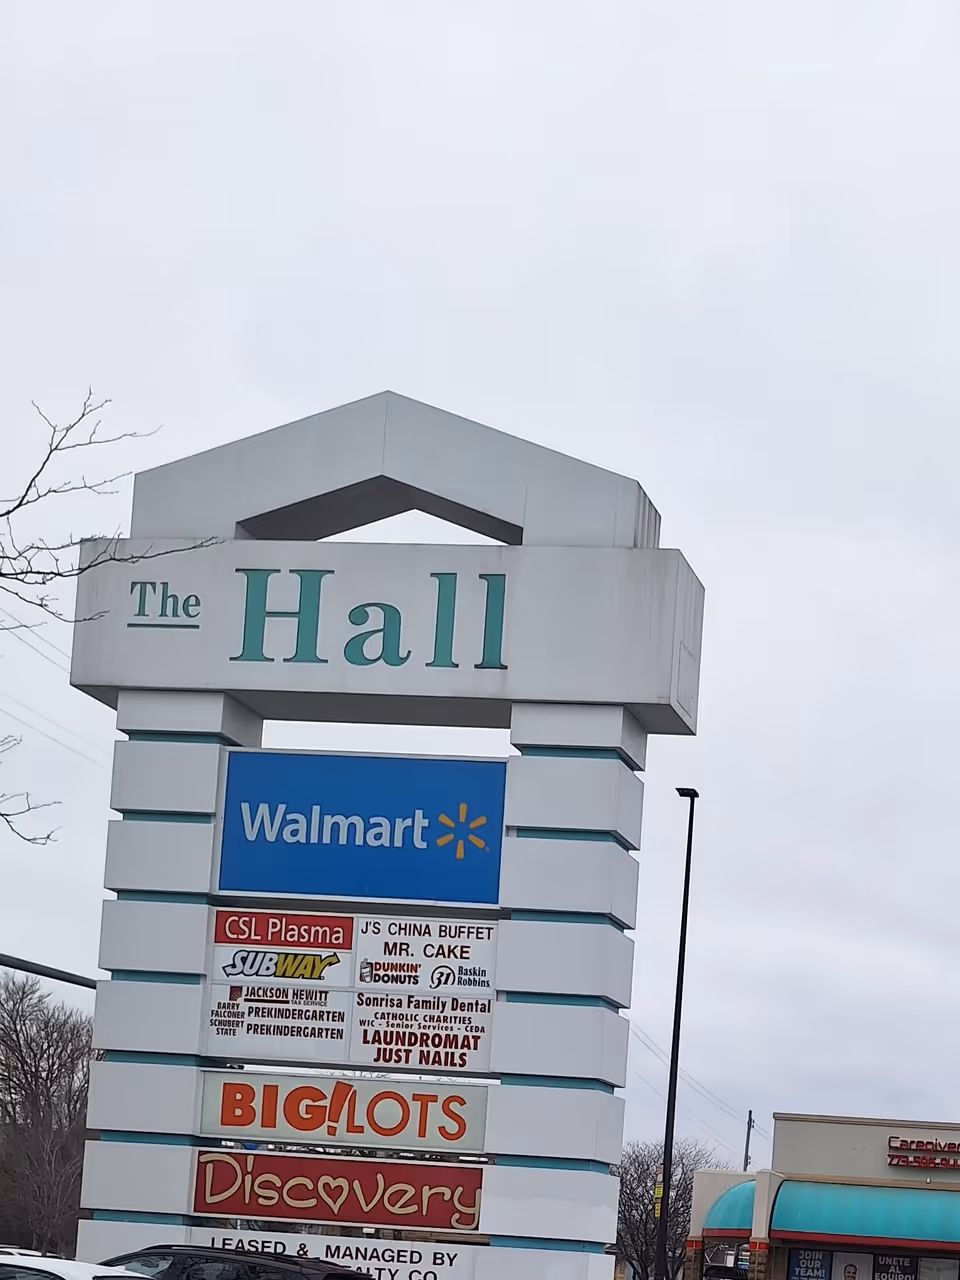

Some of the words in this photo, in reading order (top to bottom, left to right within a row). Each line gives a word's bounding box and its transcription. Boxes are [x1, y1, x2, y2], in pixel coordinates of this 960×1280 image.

[129, 581, 201, 618] The
[229, 568, 508, 671] Hall
[240, 802, 429, 848] Walmart
[225, 916, 262, 939] CSL
[267, 917, 344, 944] Plasma
[361, 921, 381, 935] J'S
[388, 922, 432, 937] CHINA
[438, 925, 494, 940] BUFFET
[383, 942, 414, 957] MR.
[423, 944, 471, 960] CAKE
[222, 950, 341, 980] SUBWAY
[374, 962, 421, 974] DUNKIN'
[457, 966, 487, 978] Baskin
[373, 973, 420, 985] DONUTS
[457, 977, 491, 988] Robbins
[244, 987, 289, 999] JACKSON
[291, 990, 329, 1001] HEWITT
[217, 1002, 240, 1010] BARRY
[357, 992, 402, 1008] Sonrisa
[407, 995, 447, 1014] Family
[451, 997, 491, 1013] Dental
[211, 1010, 245, 1019] FALCONER
[247, 1006, 345, 1023] PREKINDERGARTEN
[374, 1012, 419, 1022] CATHOLIC
[423, 1014, 472, 1025] CHARITIES
[210, 1019, 245, 1028] SCHUBERT
[359, 1019, 375, 1027] WIC
[385, 1021, 414, 1029] Senior
[417, 1023, 454, 1031] Services
[465, 1025, 485, 1033] CEDA
[216, 1028, 237, 1036] STATE
[246, 1023, 344, 1040] PREKINDERGARTEN
[362, 1029, 481, 1051] LAUNDROMAT
[373, 1047, 412, 1064] JUST
[418, 1050, 467, 1067] NAILS
[296, 1243, 309, 1257] &
[325, 1244, 423, 1265] MANAGED
[432, 1252, 458, 1267] BY
[799, 1250, 823, 1260] JOIN
[800, 1259, 821, 1268] OUR
[888, 1266, 901, 1274] AL
[794, 1267, 826, 1277] TEAM!
